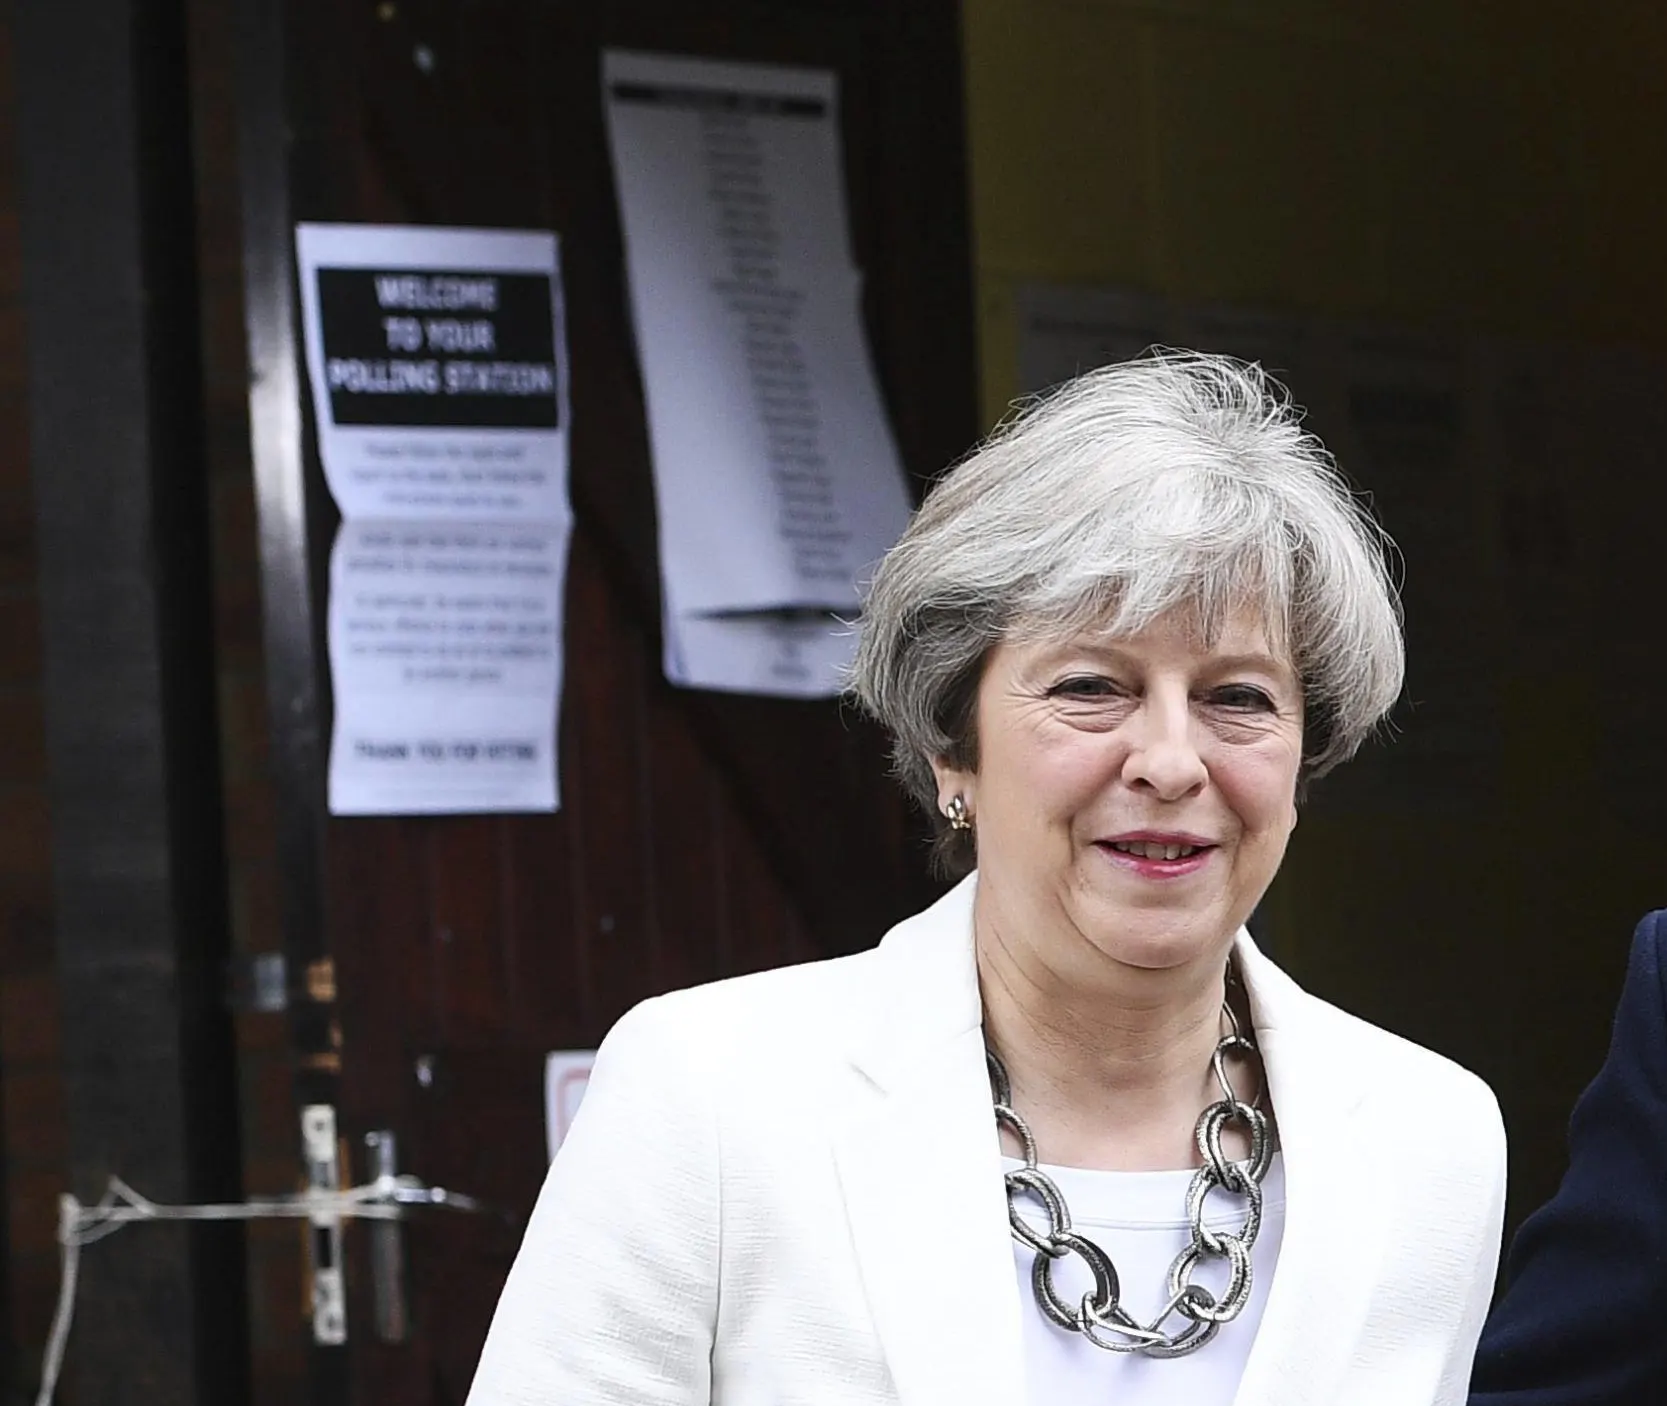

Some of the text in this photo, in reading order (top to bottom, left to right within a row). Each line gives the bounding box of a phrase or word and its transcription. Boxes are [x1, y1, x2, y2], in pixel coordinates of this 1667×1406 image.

[375, 275, 496, 310] WELCOME
[383, 317, 495, 351] TO YOUR
[328, 358, 554, 395] POLLING STATION
